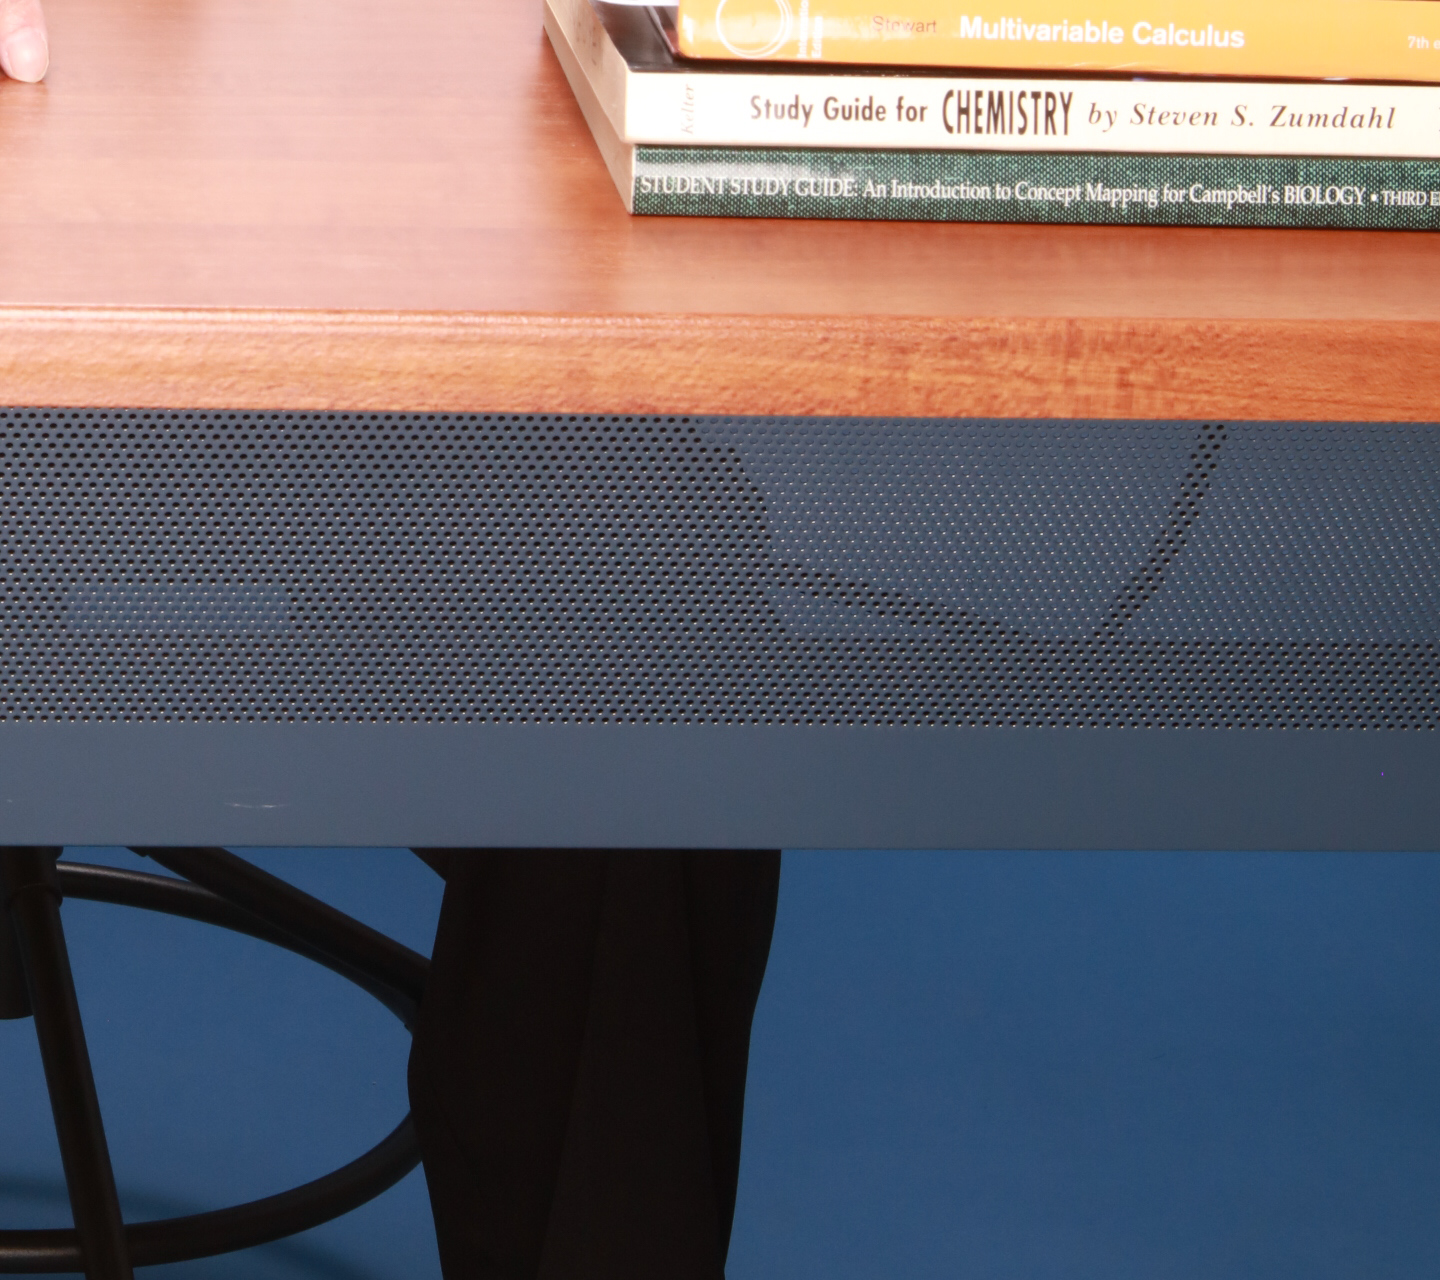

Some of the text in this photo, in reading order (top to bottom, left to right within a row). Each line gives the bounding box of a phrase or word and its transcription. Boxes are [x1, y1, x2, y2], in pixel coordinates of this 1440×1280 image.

[872, 14, 1246, 48] Stewart Multivariable Calculus
[1407, 35, 1430, 49] 7th
[680, 83, 695, 135] Kelter
[750, 89, 1396, 136] Study Guide for CHEMISTRY by Steven S. Zumdahl
[640, 175, 1440, 209] STUDENT STUDY GUIDE: An Introduction to Concept Mapping for Campbell's BIOLOGY THIRD E
